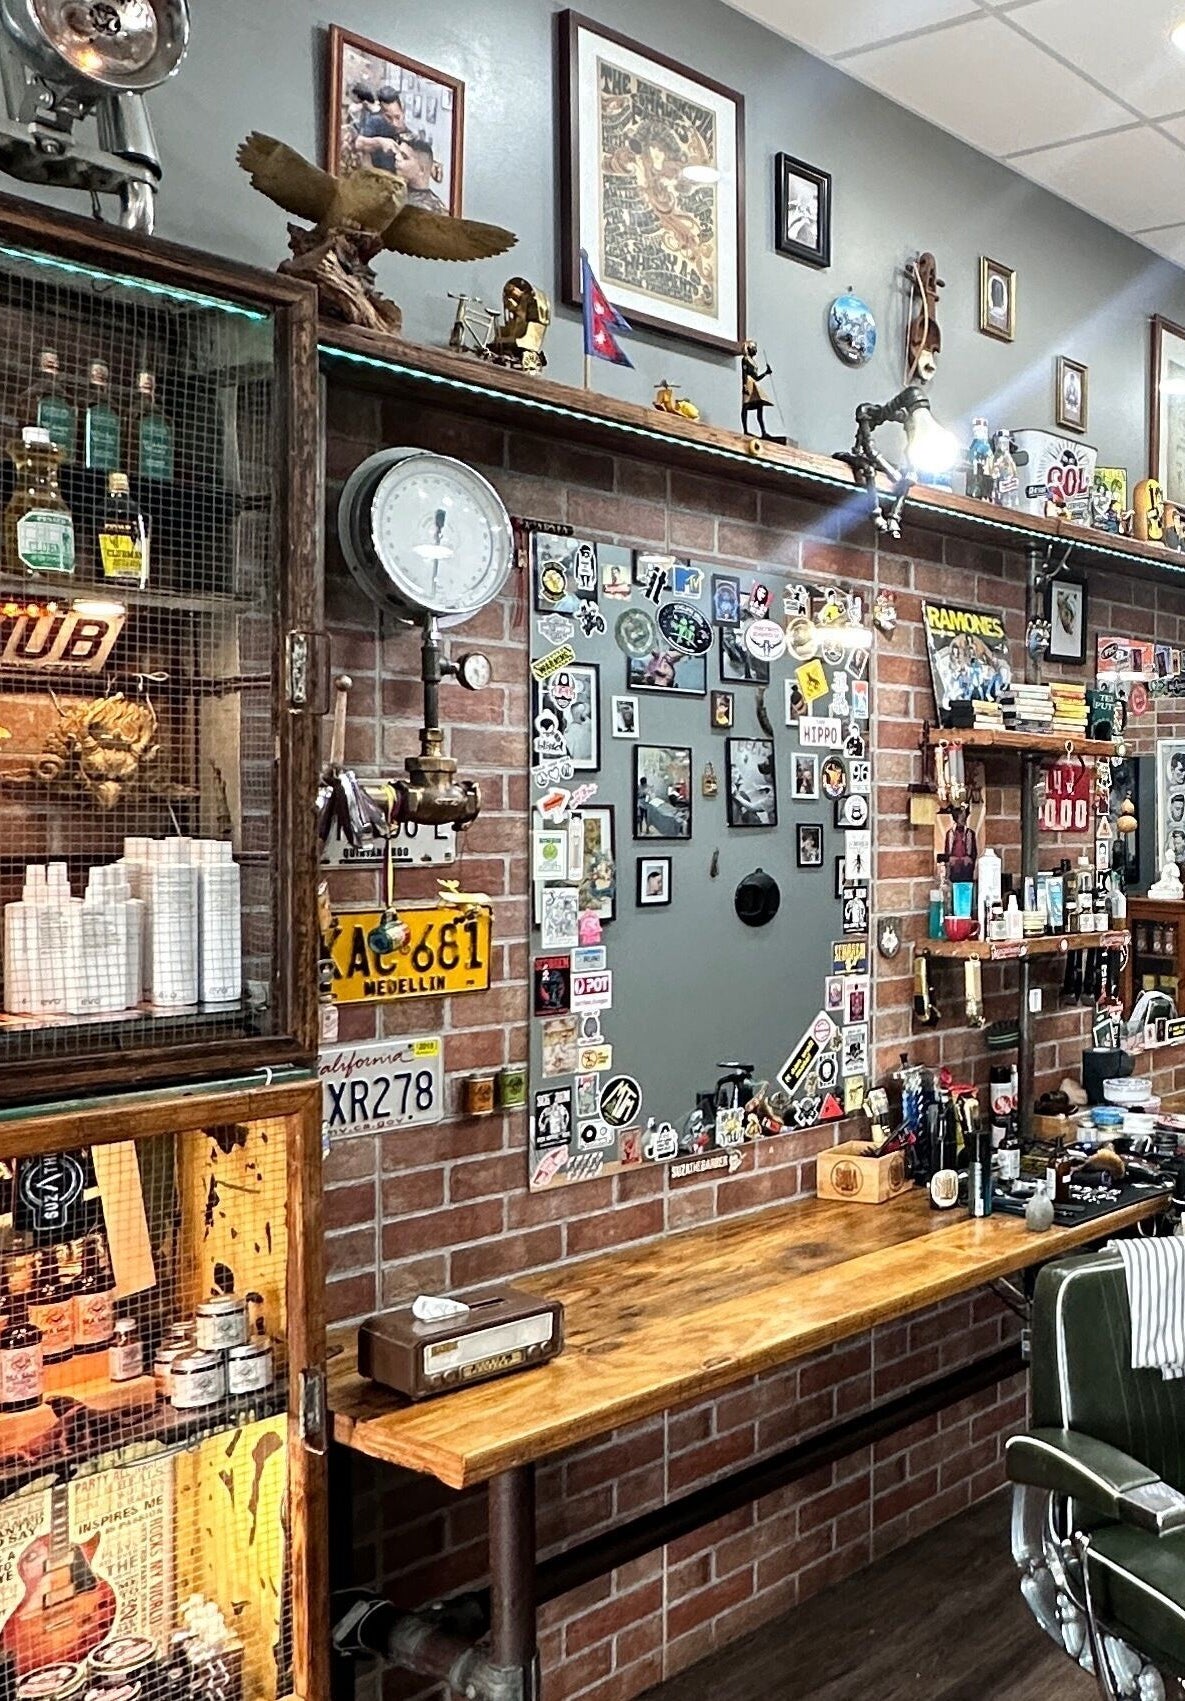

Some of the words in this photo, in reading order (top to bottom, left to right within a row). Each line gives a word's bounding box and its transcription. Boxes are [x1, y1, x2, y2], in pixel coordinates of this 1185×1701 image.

[926, 605, 1004, 640] RAMONES
[803, 726, 838, 744] HIPPO
[411, 920, 482, 974] 681
[364, 976, 446, 997] MEDELLIN
[317, 1049, 414, 1078] alifornia
[43, 1152, 57, 1174] TH
[79, 1507, 139, 1534] INSPIRES
[144, 1495, 164, 1510] ME
[107, 1556, 138, 1575] THE
